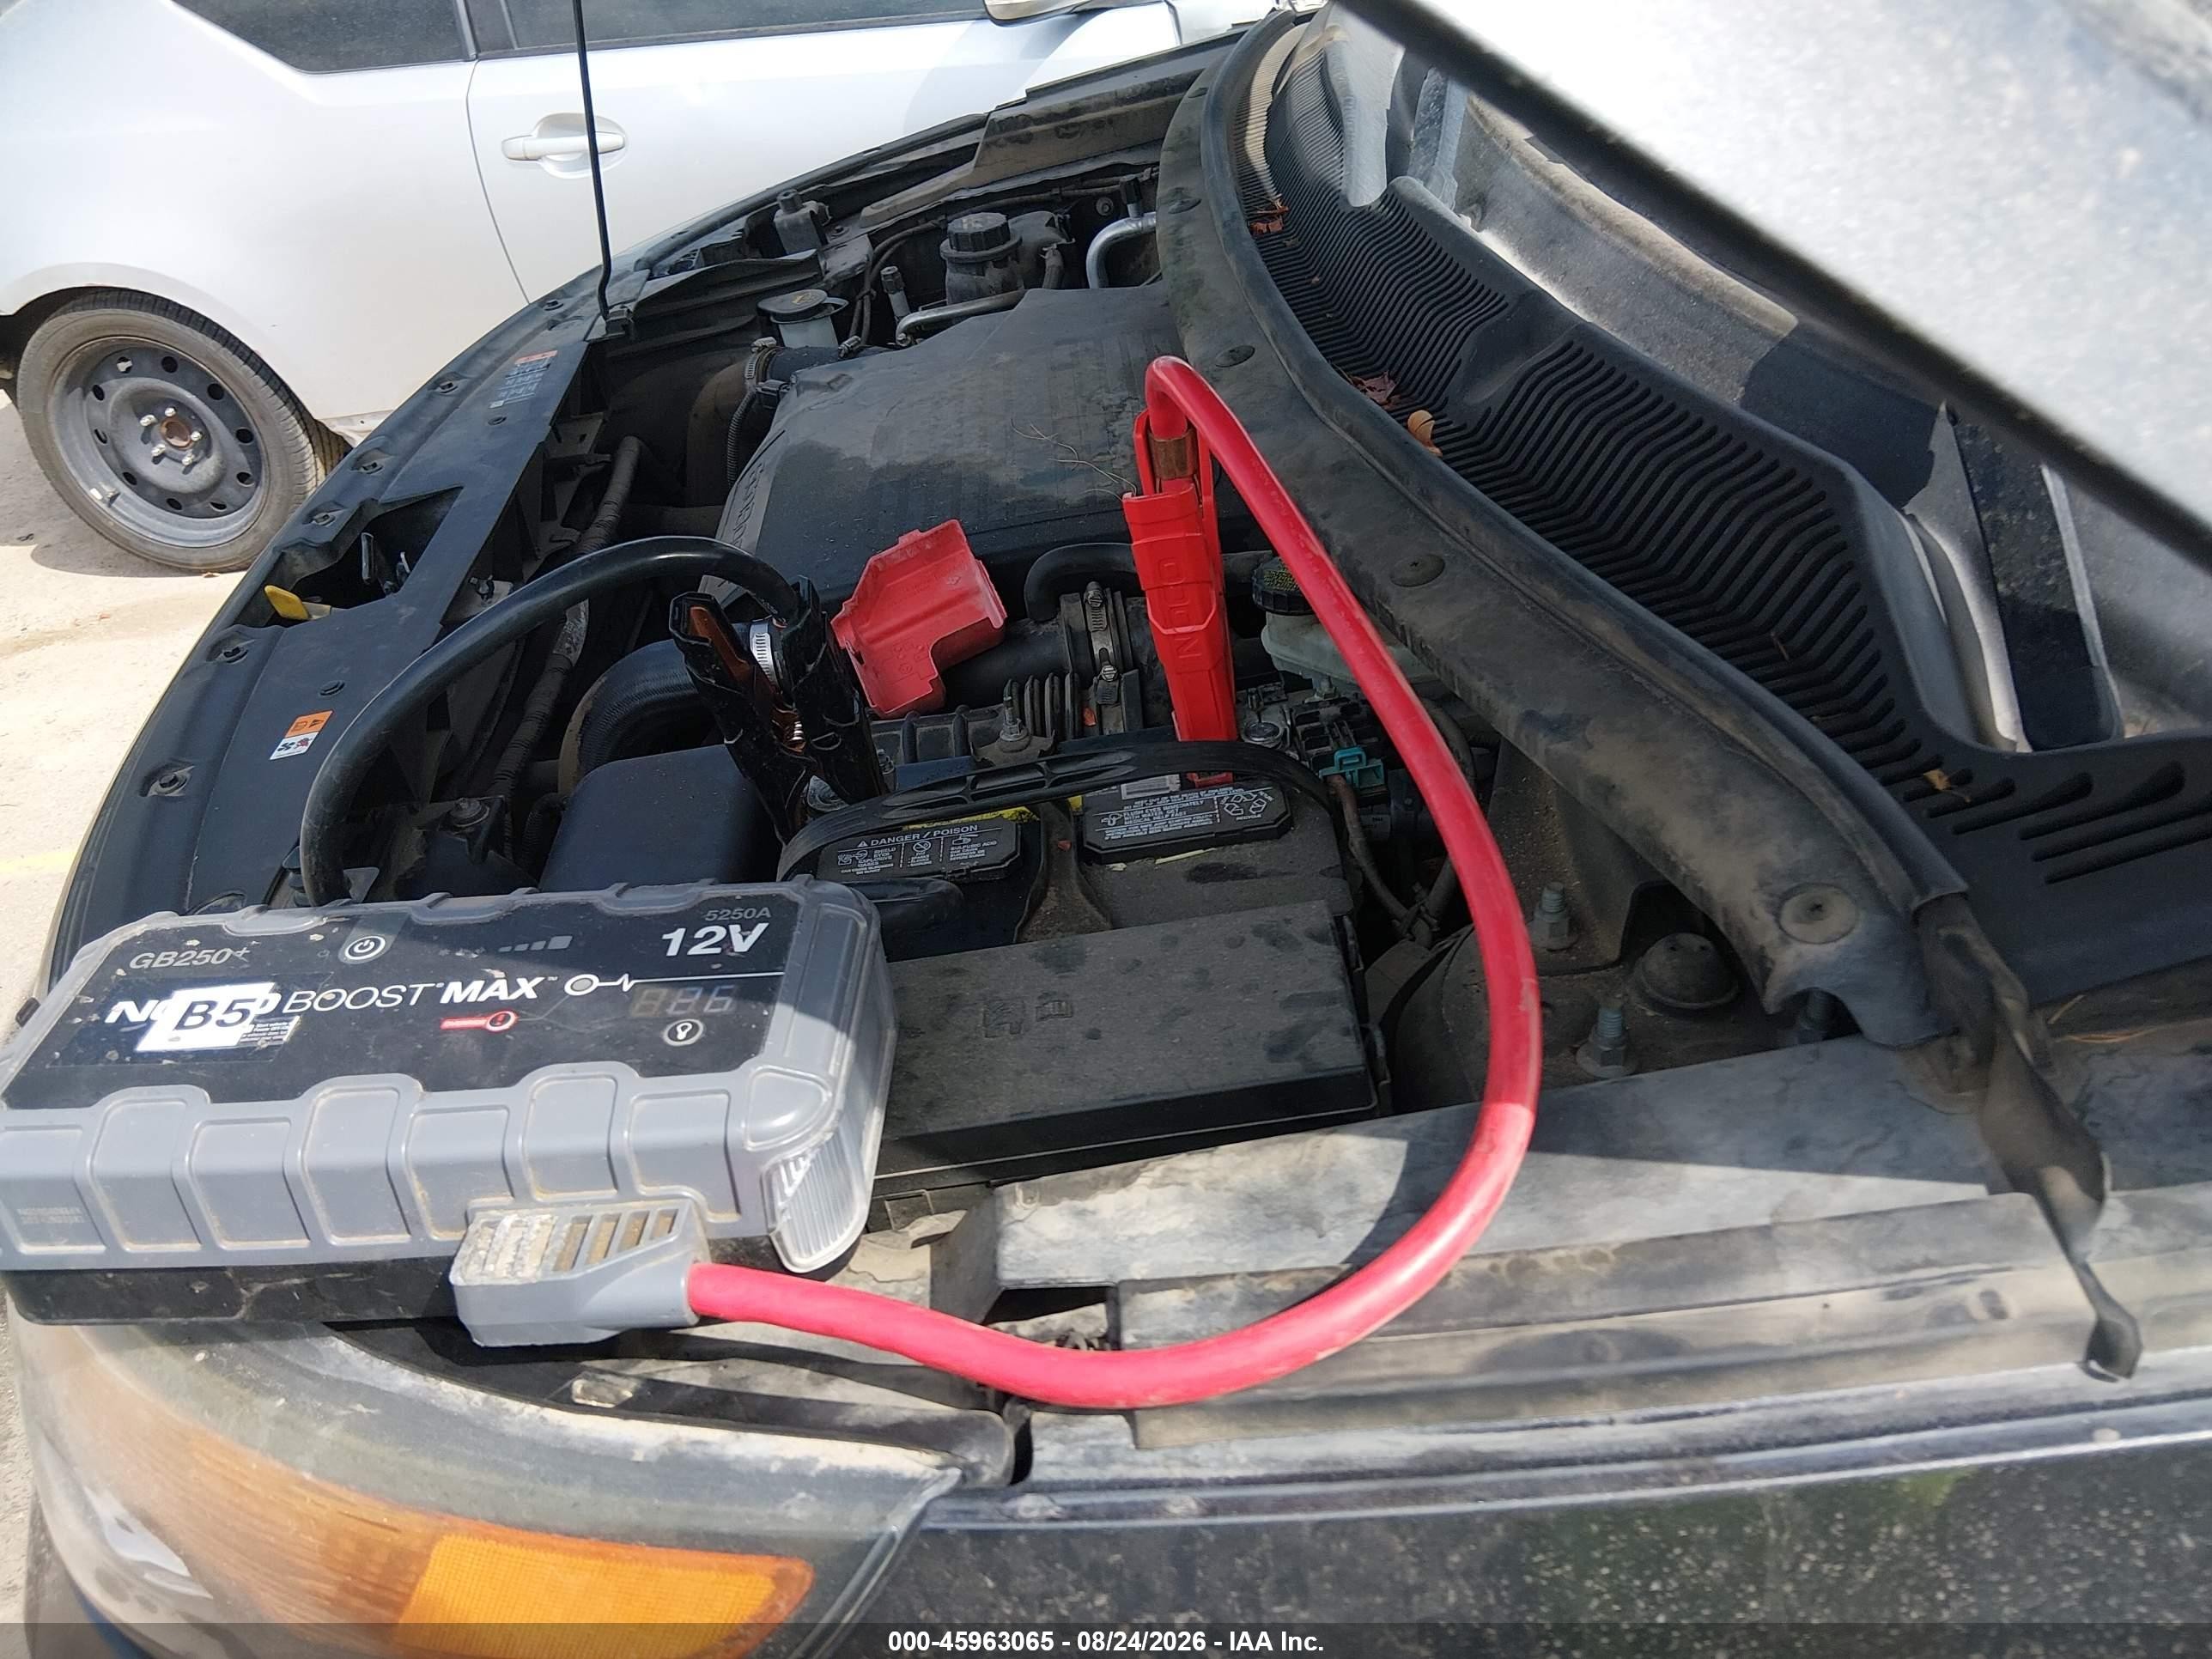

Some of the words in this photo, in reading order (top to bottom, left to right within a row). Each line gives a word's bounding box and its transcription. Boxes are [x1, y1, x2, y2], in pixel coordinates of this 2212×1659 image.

[871, 833, 921, 847] DANGER
[933, 824, 978, 837] POISON
[705, 908, 772, 921] 5250A
[662, 922, 770, 957] 12V
[130, 947, 251, 969] GB250+
[173, 997, 258, 1031] B5
